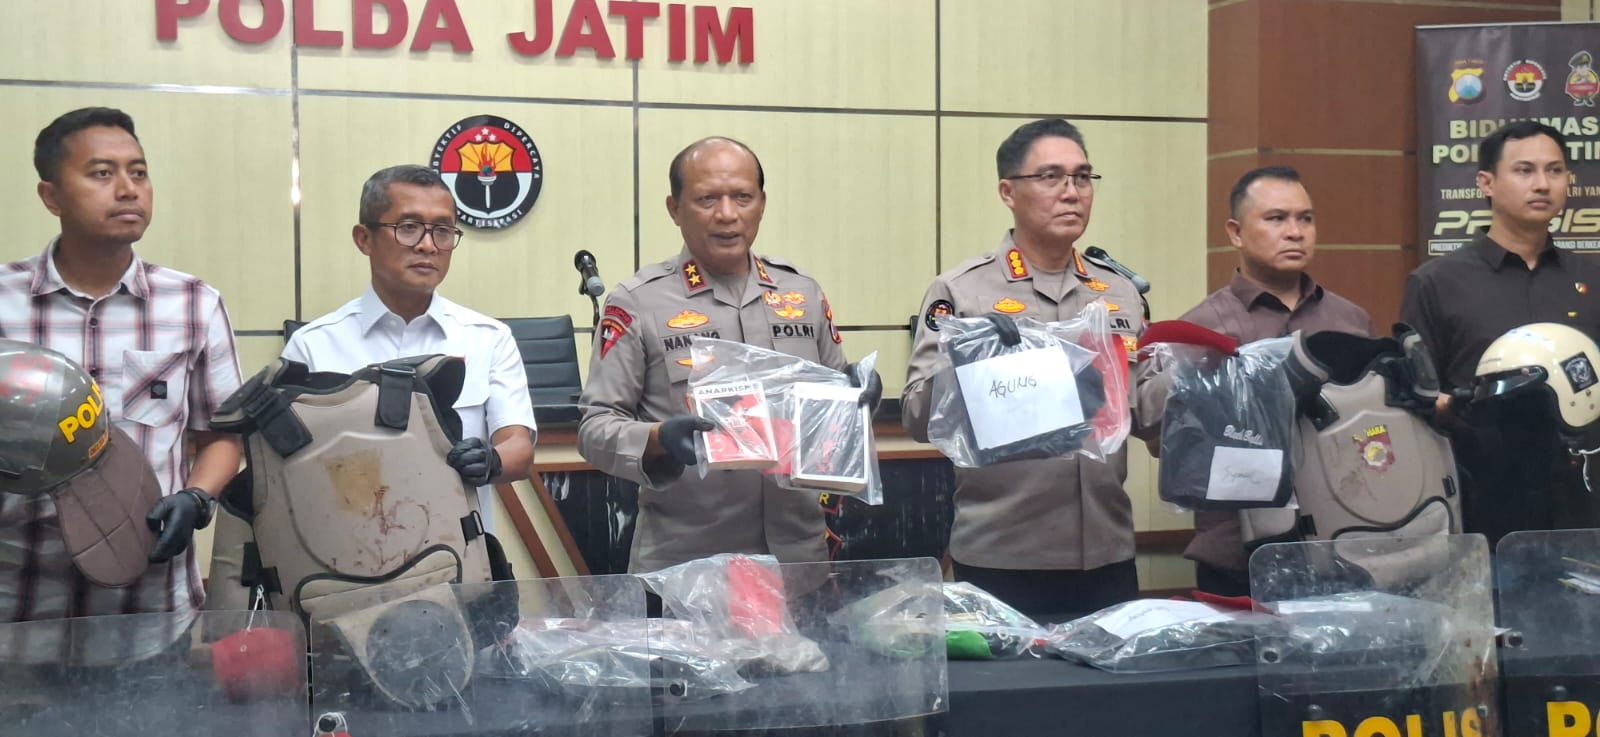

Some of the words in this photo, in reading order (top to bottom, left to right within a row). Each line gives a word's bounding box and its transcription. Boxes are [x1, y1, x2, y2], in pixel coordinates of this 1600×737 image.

[155, 0, 474, 53] POLDA
[507, 0, 755, 64] JATIM
[503, 121, 540, 179] DIPERCAYA
[772, 325, 815, 338] POLRI
[988, 375, 1037, 399] AGUNG
